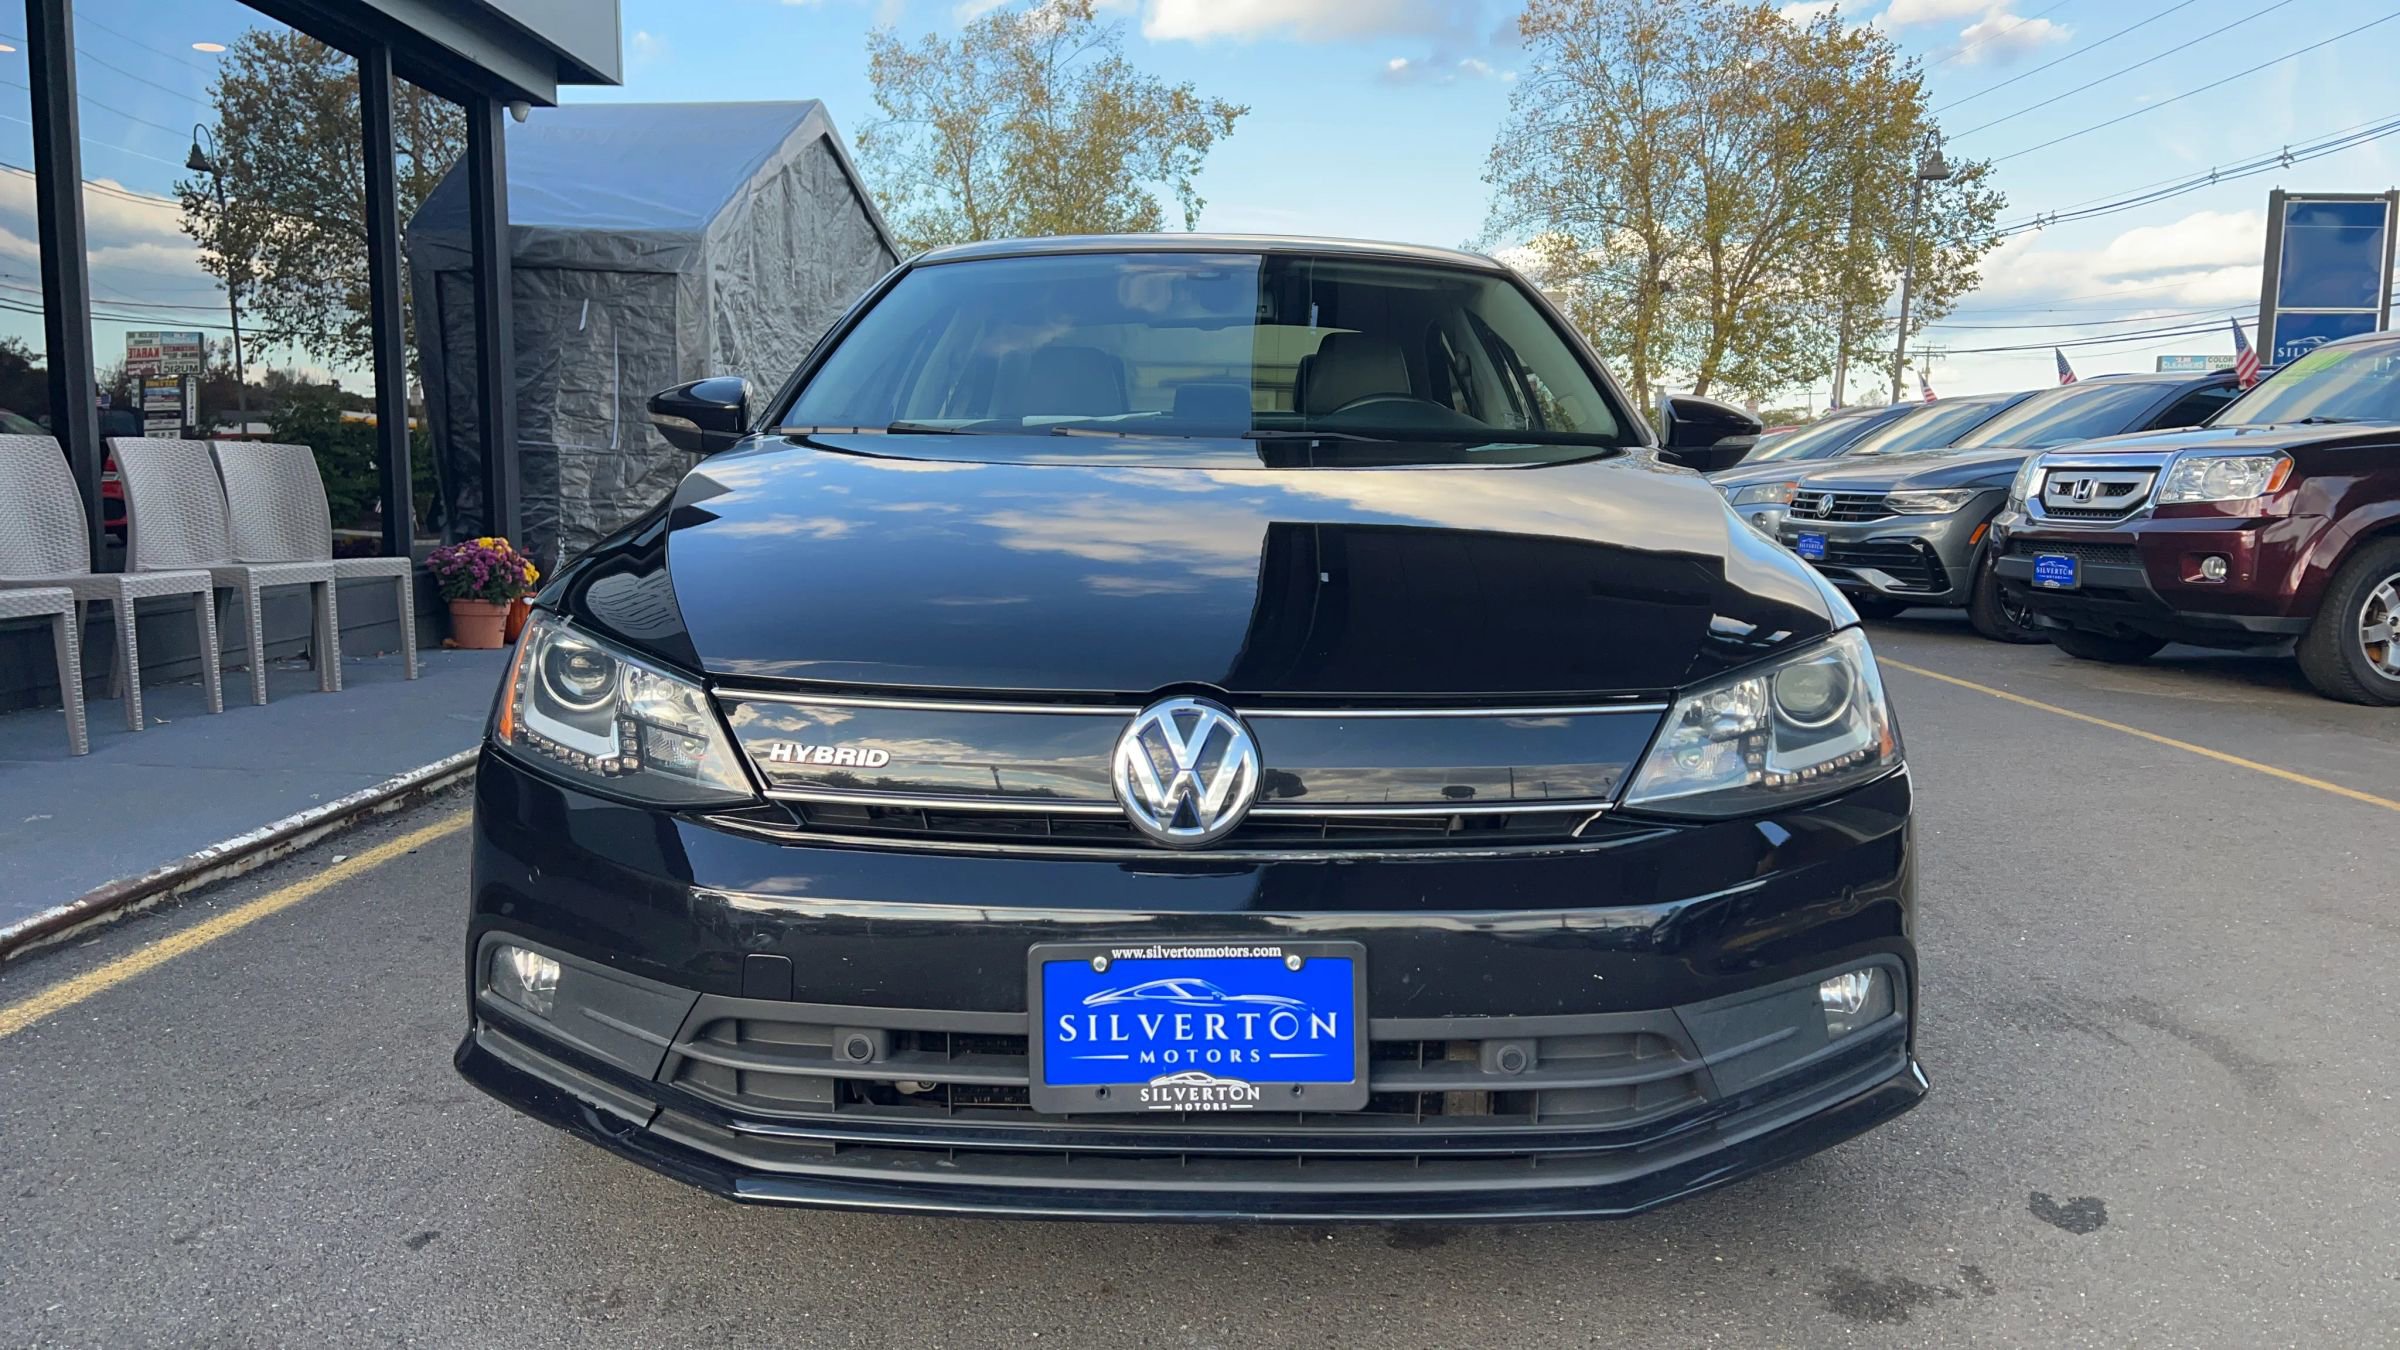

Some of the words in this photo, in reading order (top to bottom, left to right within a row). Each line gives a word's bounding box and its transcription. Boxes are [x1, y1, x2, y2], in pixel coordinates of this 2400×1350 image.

[2036, 567, 2073, 576] SILVERTON
[769, 743, 890, 768] HYBRID
[1111, 945, 1282, 960] www.silvertonmotors.com
[1058, 1011, 1338, 1042] SILVERTON
[1139, 1049, 1261, 1064] MOTORS
[1139, 1086, 1260, 1102] SILVERTON
[1174, 1102, 1229, 1111] MOTORS
